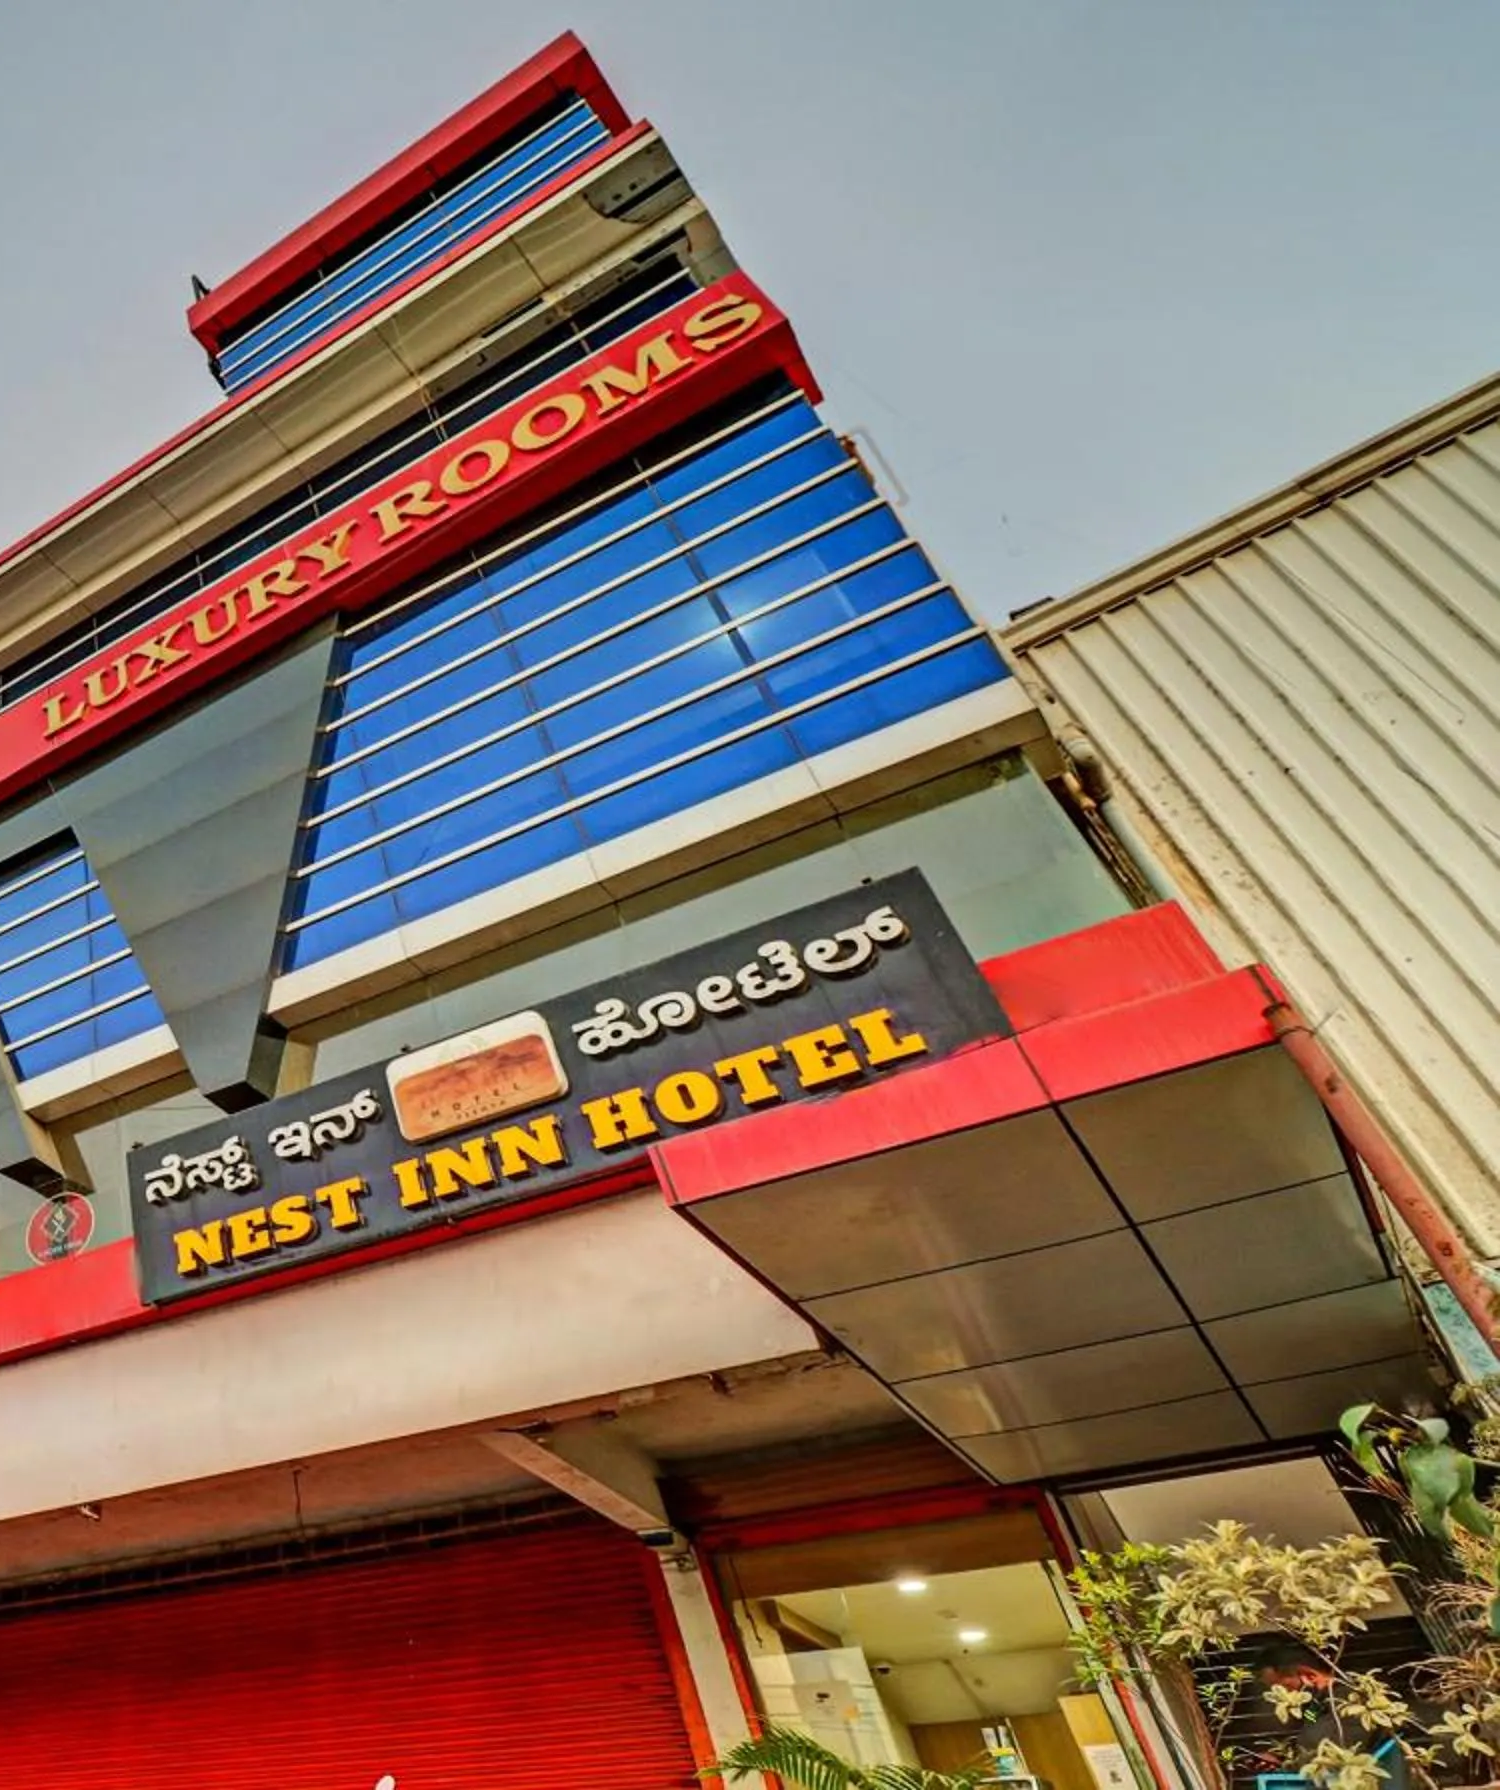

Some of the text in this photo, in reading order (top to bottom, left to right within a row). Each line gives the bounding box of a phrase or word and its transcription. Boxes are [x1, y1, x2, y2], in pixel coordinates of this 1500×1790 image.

[41, 518, 359, 739] LUXURY
[369, 294, 762, 541] ROOMS
[173, 1008, 927, 1276] NEST INN HOTEL
[267, 1087, 381, 1159] ಇನ್
[571, 904, 905, 1056] ಹೋಟೆಲ್
